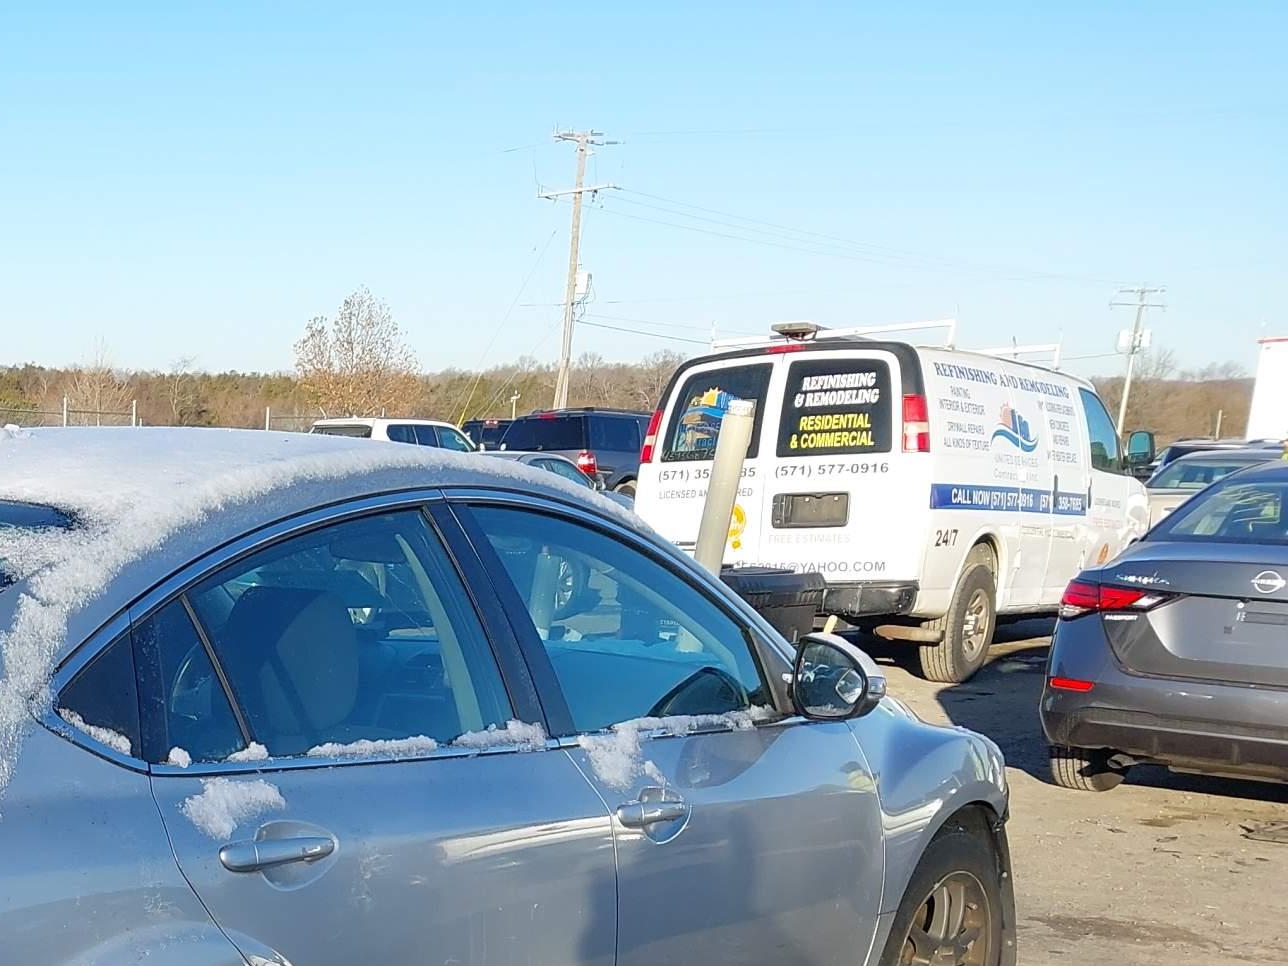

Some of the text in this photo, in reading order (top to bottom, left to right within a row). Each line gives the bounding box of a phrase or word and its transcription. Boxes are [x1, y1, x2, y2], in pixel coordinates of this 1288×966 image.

[802, 372, 877, 391] REFINISHING
[934, 362, 1069, 399] REFINISHING AND REMODELING
[805, 388, 880, 407] REMODELING
[800, 413, 871, 431] RESIDENTIAL
[790, 431, 874, 448] & COMMERCIAL
[658, 468, 690, 482] (571)
[775, 462, 889, 479] (571) 577-0916
[659, 489, 696, 499] LICENSED
[952, 488, 971, 504] CALL
[972, 489, 990, 506] NOW
[935, 529, 959, 547] 24/7
